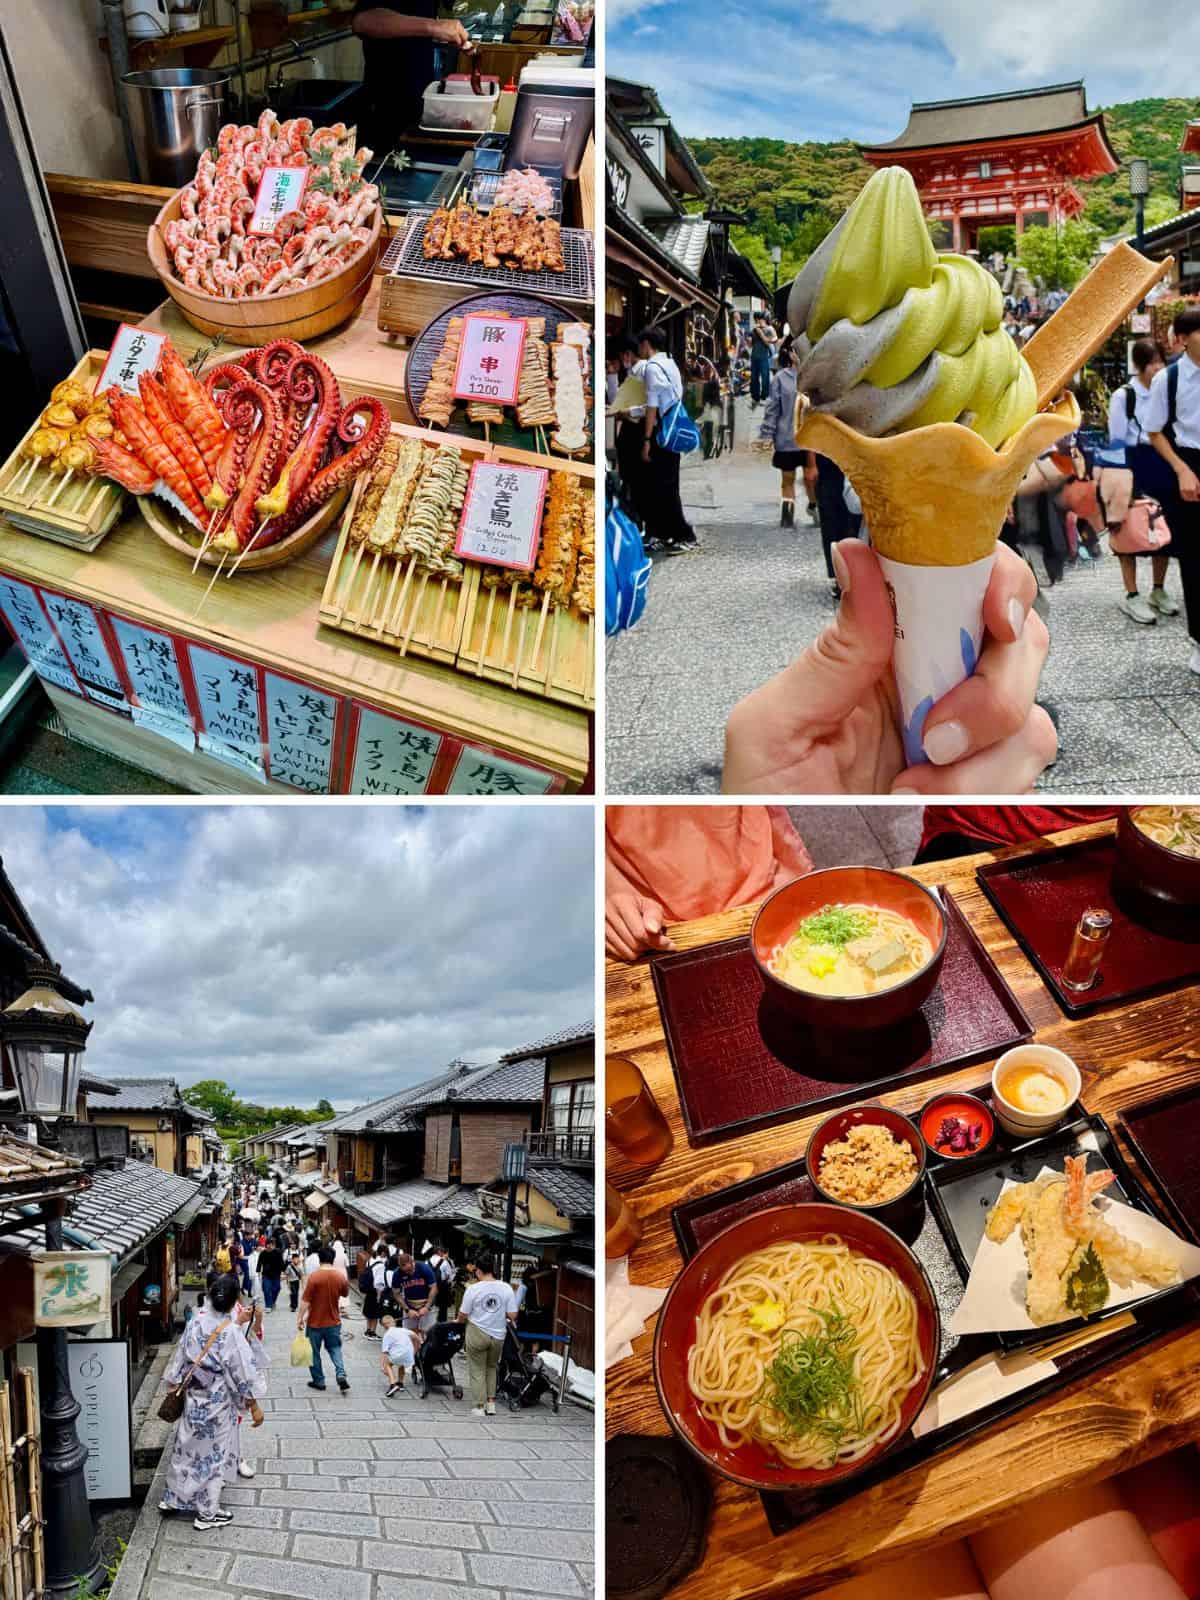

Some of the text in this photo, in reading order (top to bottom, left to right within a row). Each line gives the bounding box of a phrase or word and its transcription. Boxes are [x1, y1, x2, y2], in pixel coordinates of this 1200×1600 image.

[270, 172, 292, 214] 海老串
[119, 334, 147, 381] ホタテ串
[480, 326, 506, 374] 豚串
[468, 382, 499, 396] 1200
[489, 473, 519, 529] 焼き鳥
[48, 604, 100, 668] 焼き鳥
[144, 637, 180, 691] 焼き鳥
[228, 668, 260, 720] 焼き鳥
[208, 720, 257, 746] MAYO
[217, 709, 260, 736] WITH
[298, 694, 336, 746] 焼き鳥
[273, 752, 328, 777] CAVIAR
[280, 743, 325, 767] WITH
[398, 731, 437, 784] 焼き鳥
[84, 1384, 99, 1430] APPLE
